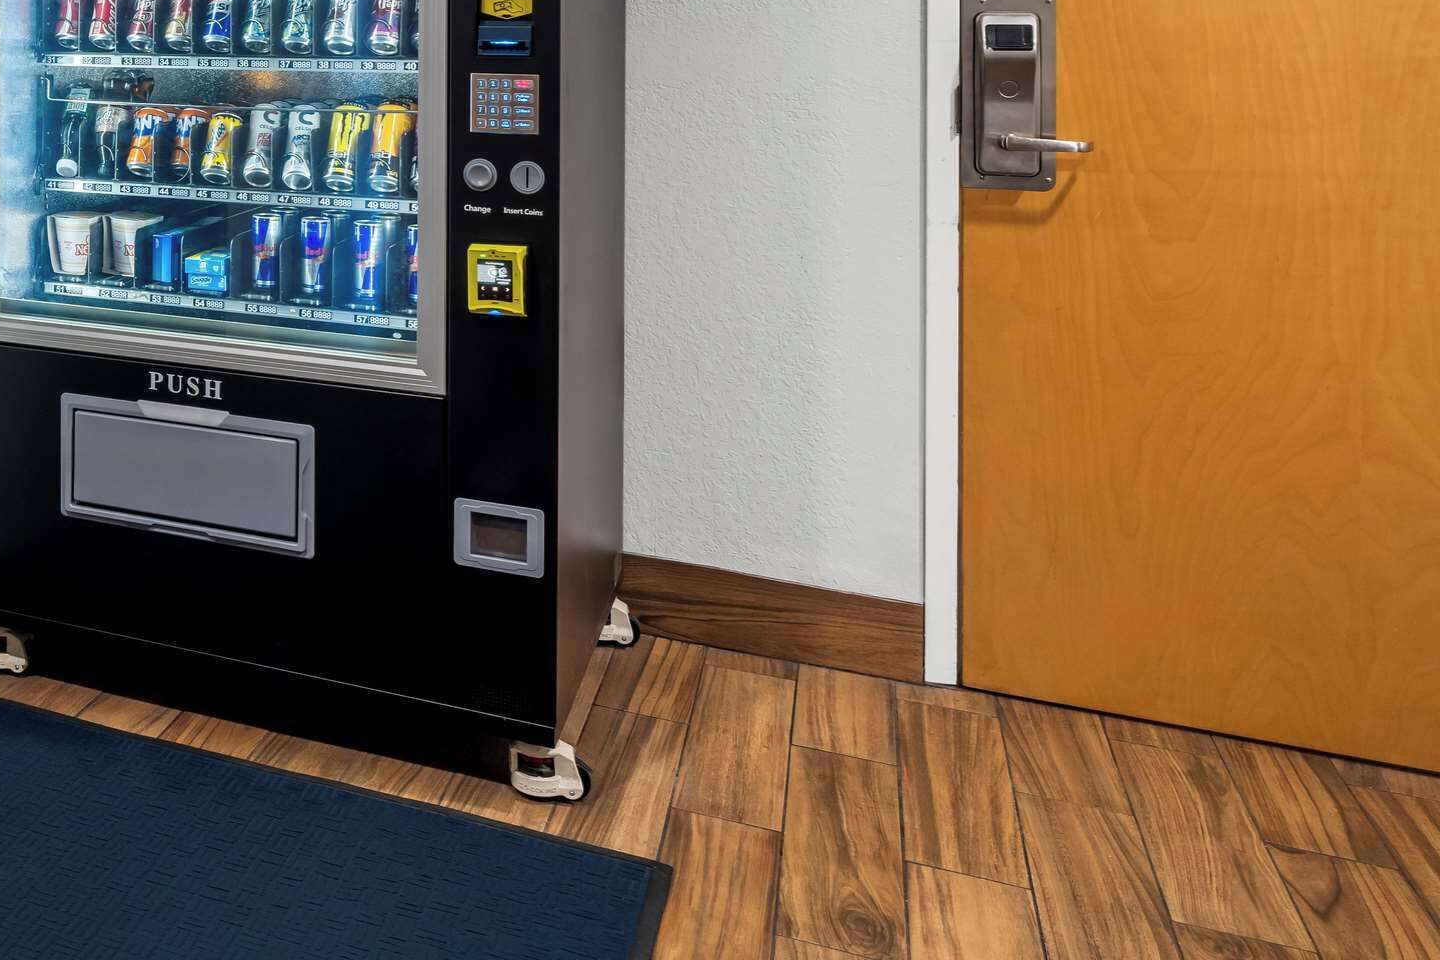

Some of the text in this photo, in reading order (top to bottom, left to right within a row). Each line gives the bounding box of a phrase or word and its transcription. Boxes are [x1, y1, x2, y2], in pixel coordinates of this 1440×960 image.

[122, 57, 133, 65] 33
[160, 58, 170, 66] 34
[198, 59, 209, 67] 35
[238, 60, 249, 68] 36
[279, 60, 290, 68] 37
[318, 60, 329, 69] 38
[362, 61, 374, 70] 39
[405, 62, 417, 70] 40
[120, 185, 130, 193] 43
[159, 188, 169, 196] 44
[197, 190, 207, 198] 45
[237, 192, 248, 201] 46
[278, 195, 289, 203] 47
[319, 198, 330, 206] 48
[367, 200, 378, 209] 49
[463, 204, 492, 214] Change
[503, 206, 544, 217] Insert Coins
[152, 295, 161, 303] 53
[195, 299, 205, 307] 54
[247, 304, 258, 313] 55
[301, 309, 312, 318] 56
[356, 315, 367, 324] 57
[148, 371, 223, 400] PUSH
